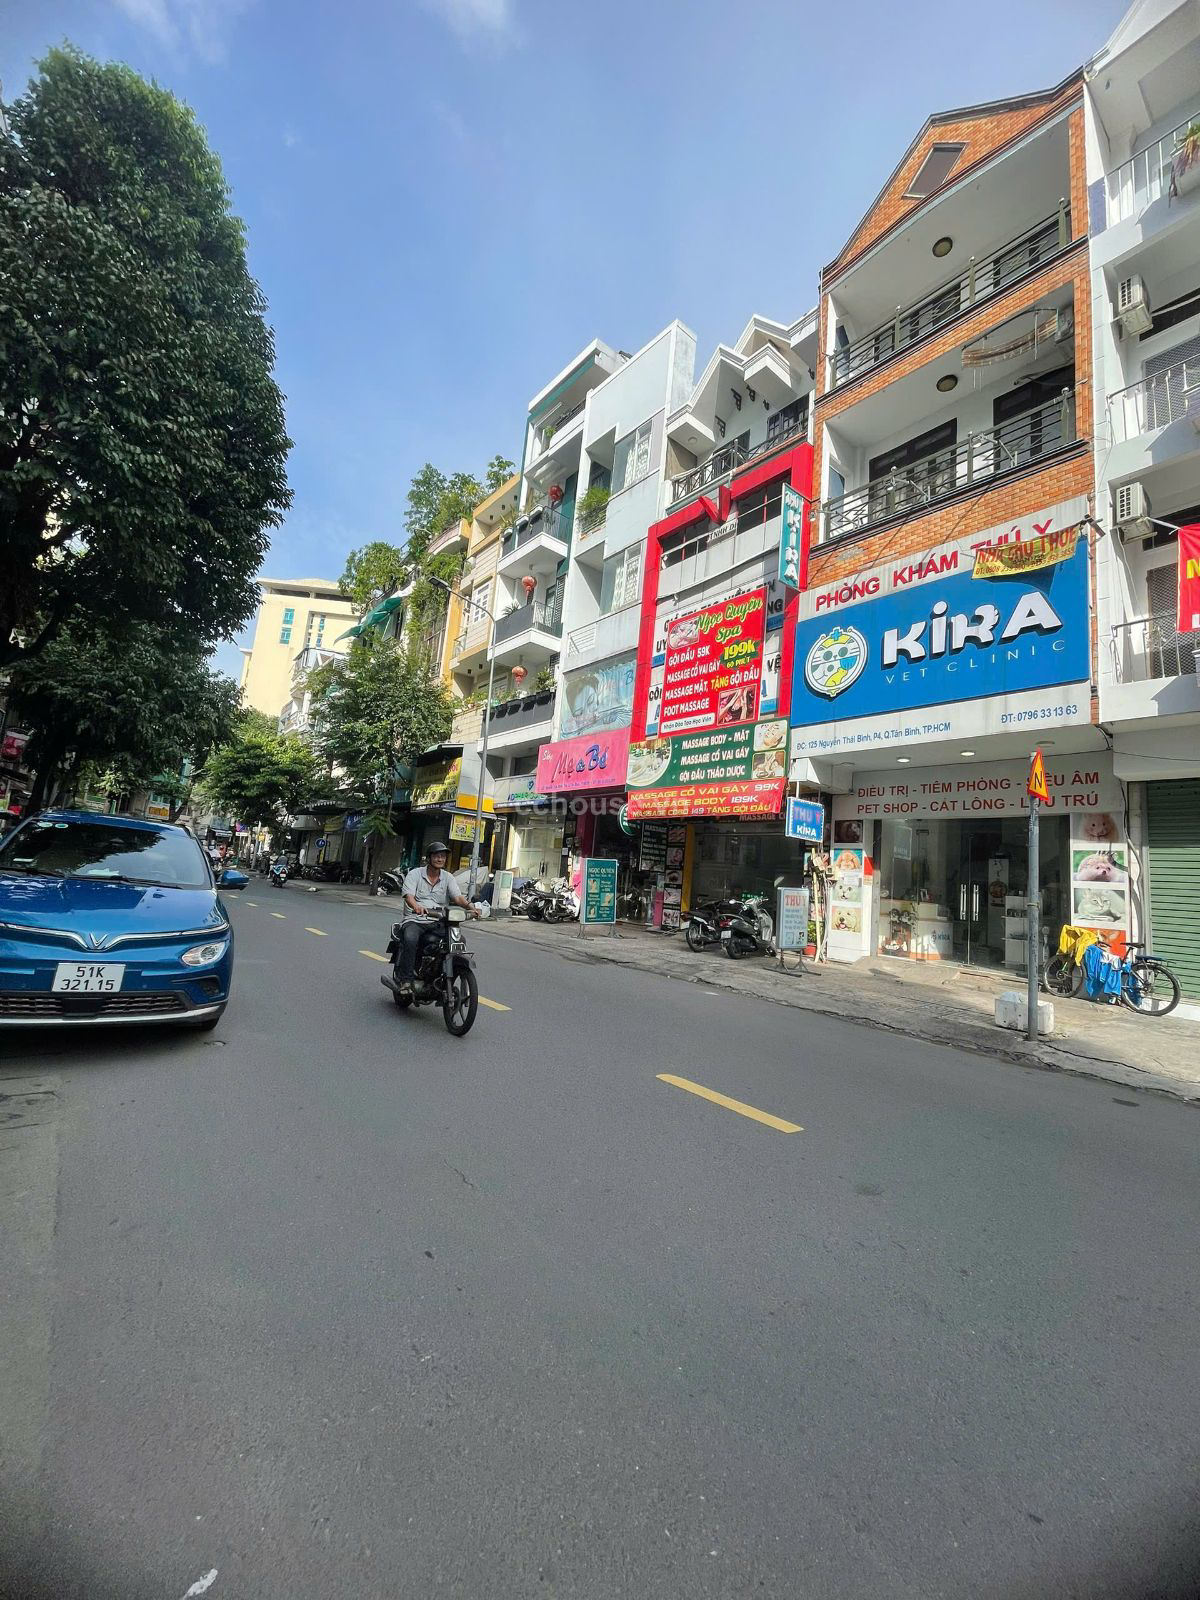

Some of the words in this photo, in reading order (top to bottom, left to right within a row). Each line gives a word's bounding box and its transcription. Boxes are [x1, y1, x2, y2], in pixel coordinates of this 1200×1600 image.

[815, 577, 880, 611] PHÒNG
[893, 551, 959, 587] KHÁM
[715, 625, 742, 644] Spa
[697, 645, 710, 658] 59K
[886, 668, 927, 684] VET
[947, 640, 1065, 672] CLINIC
[667, 668, 690, 684] MASSAGE
[699, 664, 708, 675] VAI
[665, 684, 693, 700] MASSAGE
[664, 703, 679, 717] FOOT
[680, 698, 709, 713] MASSAGE
[1001, 713, 1016, 724] ĐT:
[1017, 710, 1038, 722] 0796
[1040, 707, 1052, 718] 33
[1053, 706, 1063, 717] 13
[1065, 705, 1078, 715] 63
[681, 736, 710, 750] MASSAGE
[711, 734, 727, 745] BODY
[808, 740, 818, 749] 125
[922, 722, 951, 735] TP.HCM
[680, 752, 710, 766] MASSAGE
[722, 750, 733, 760] VAI
[735, 746, 750, 758] GÁY
[707, 765, 725, 779] THẢO
[630, 790, 677, 800] MASSAGE
[699, 786, 719, 795] VAI
[754, 782, 780, 791] 99K
[889, 785, 909, 797] TRỊ
[920, 781, 952, 794] TIÊM
[957, 777, 1011, 792] PHÒNG
[1071, 770, 1099, 785] ÂM
[642, 799, 691, 808] MASSAGE
[694, 797, 726, 806] BODY
[731, 795, 758, 803] 189K
[857, 804, 880, 814] PET
[883, 802, 918, 813] SHOP
[963, 797, 1005, 811] LÔNG
[1020, 795, 1055, 808] LU
[1061, 791, 1099, 807] TRÚ
[76, 966, 106, 978] 51K
[60, 979, 115, 991] 321.15
